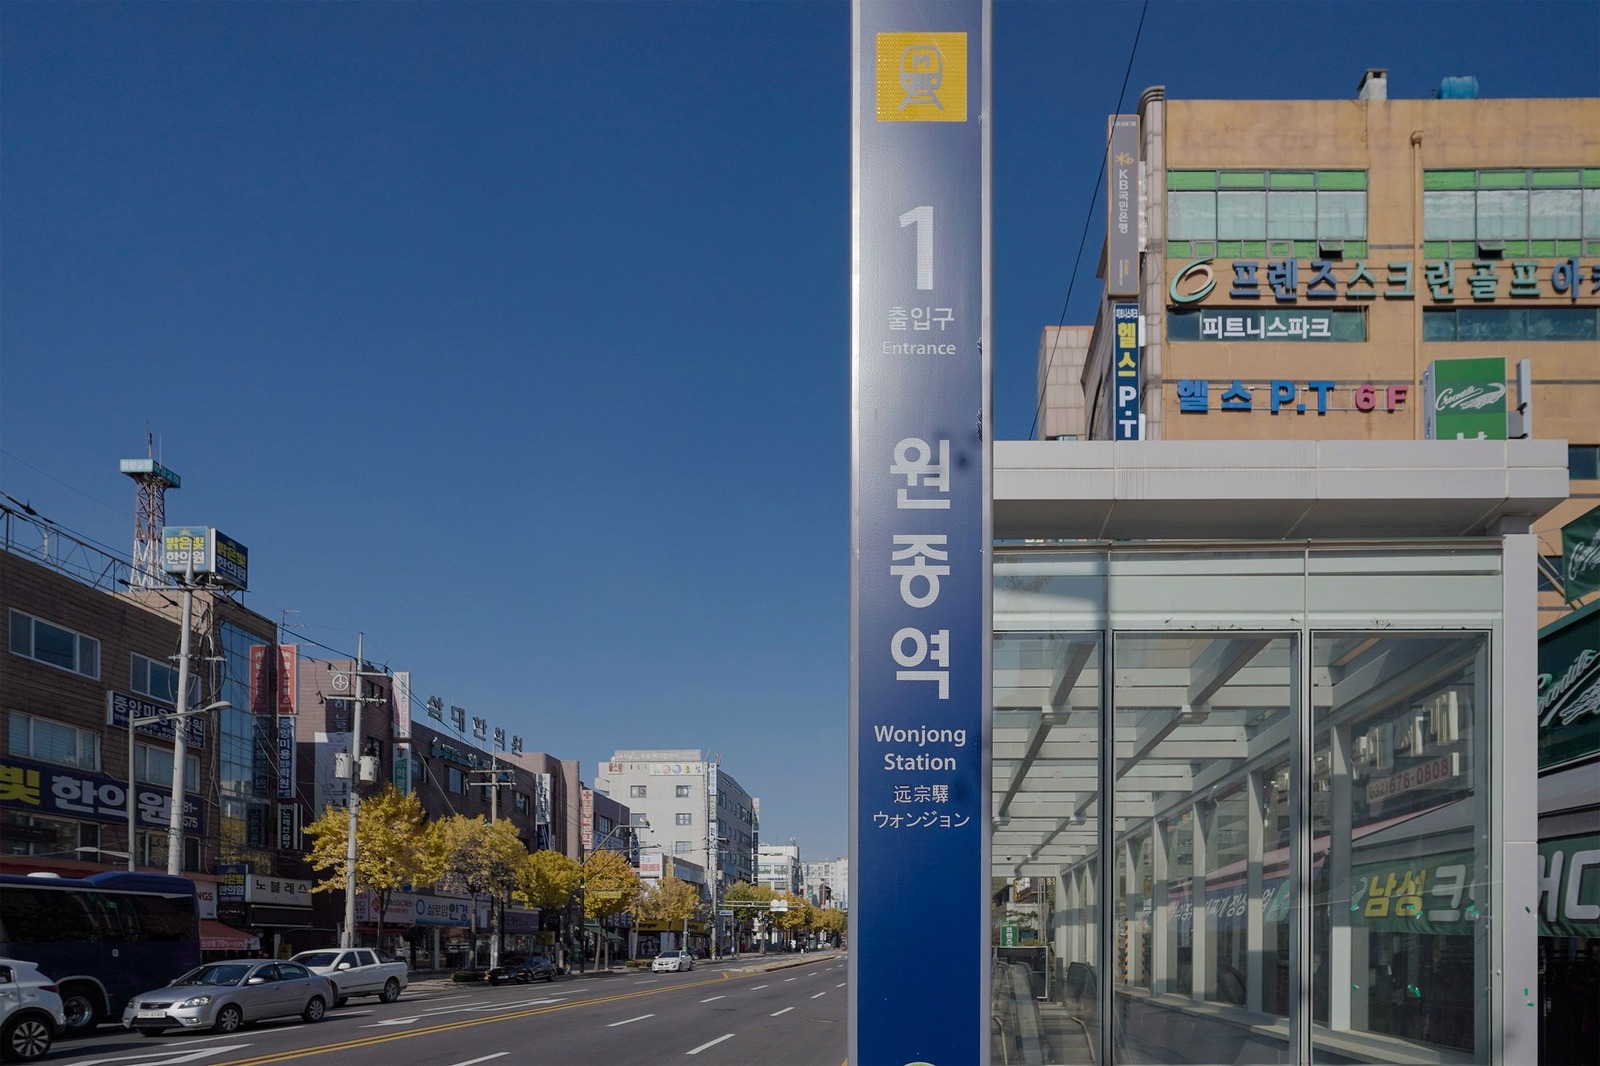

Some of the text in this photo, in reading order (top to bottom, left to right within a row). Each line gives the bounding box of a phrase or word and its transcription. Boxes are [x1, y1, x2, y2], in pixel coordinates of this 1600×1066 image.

[1118, 169, 1130, 234] KB국민은행
[899, 205, 934, 290] 1
[887, 306, 955, 331] 출입구
[1202, 315, 1331, 340] 피트니스파크
[882, 340, 956, 356] Entrance
[1117, 322, 1137, 377] 헬스
[1177, 379, 1408, 416] 헬스 P.T 6F
[166, 551, 205, 565] 한의원
[889, 437, 951, 701] 원종역
[874, 725, 967, 748] Wonjong
[883, 753, 957, 772] Station
[51, 775, 171, 826] 한의원
[873, 810, 970, 829] ウォンジョン
[255, 880, 308, 895] 노블레스
